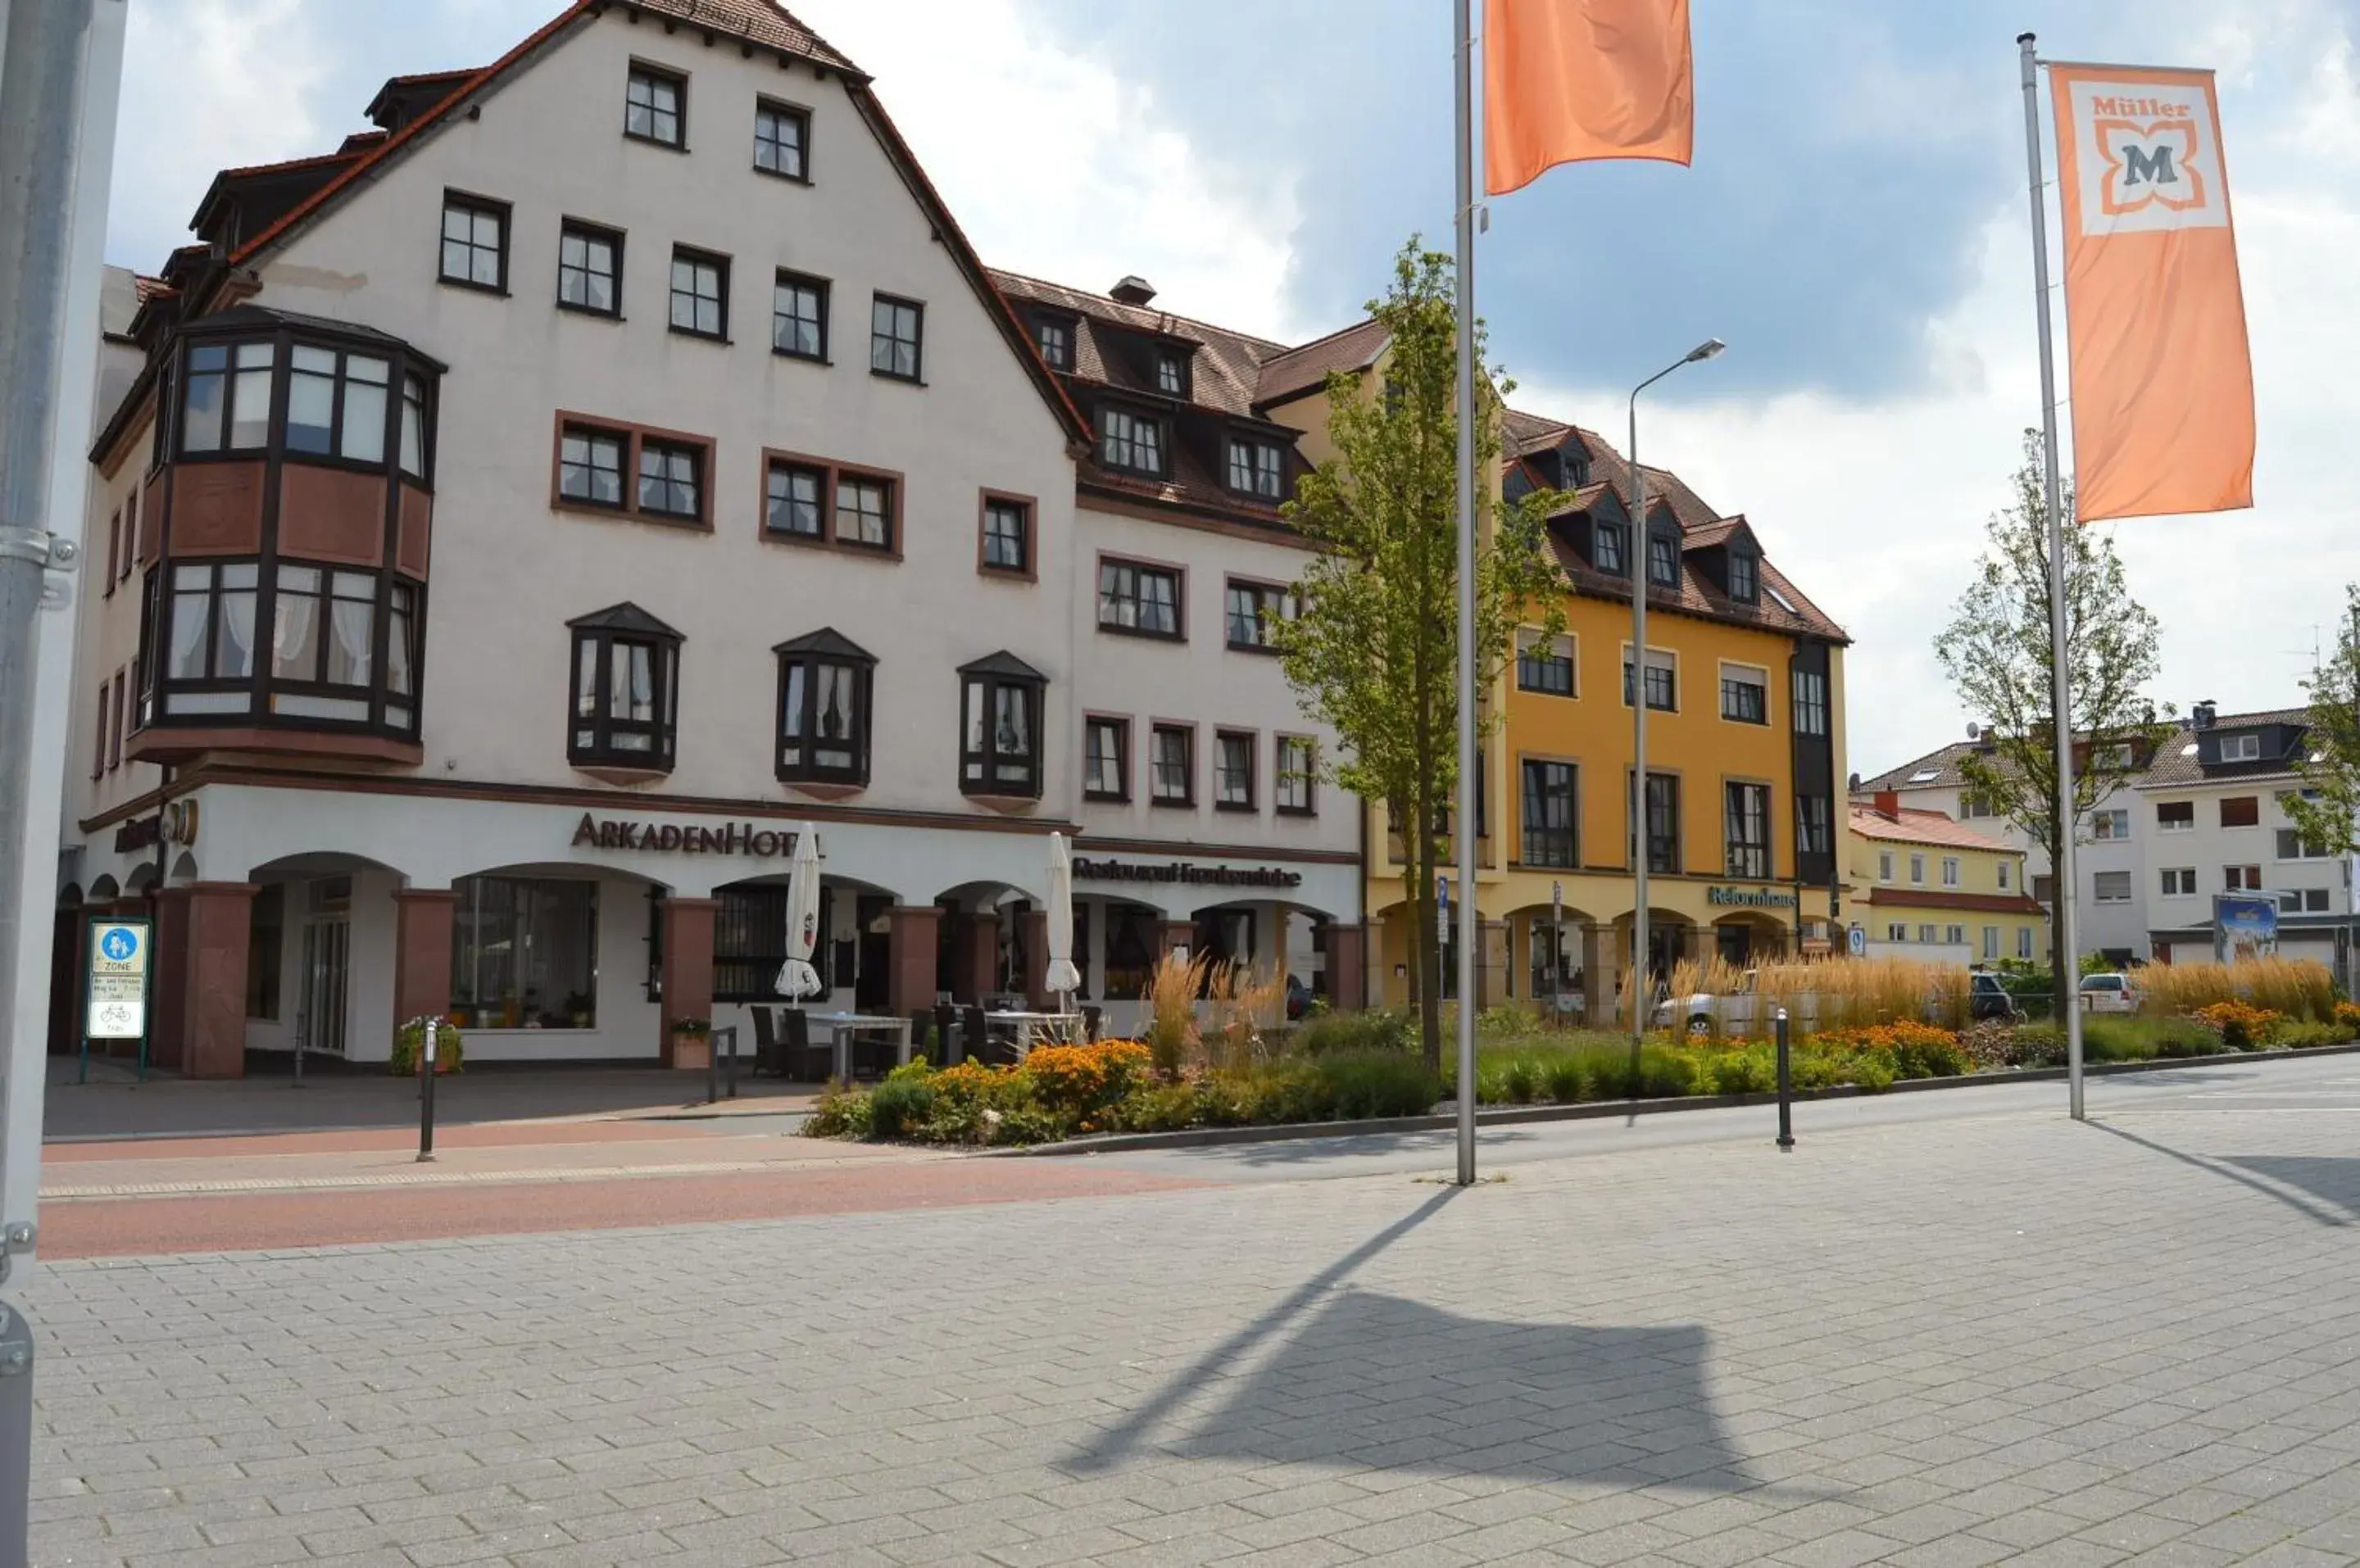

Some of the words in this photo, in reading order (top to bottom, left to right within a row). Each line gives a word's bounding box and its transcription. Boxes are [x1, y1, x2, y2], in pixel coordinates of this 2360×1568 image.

[2092, 95, 2190, 117] Müller
[2122, 144, 2178, 185] M
[571, 812, 827, 859] ARKADENHOTL
[1072, 857, 1178, 881] Restaurant
[1709, 886, 1797, 907] Reformhaus
[105, 962, 132, 971] ZONE
